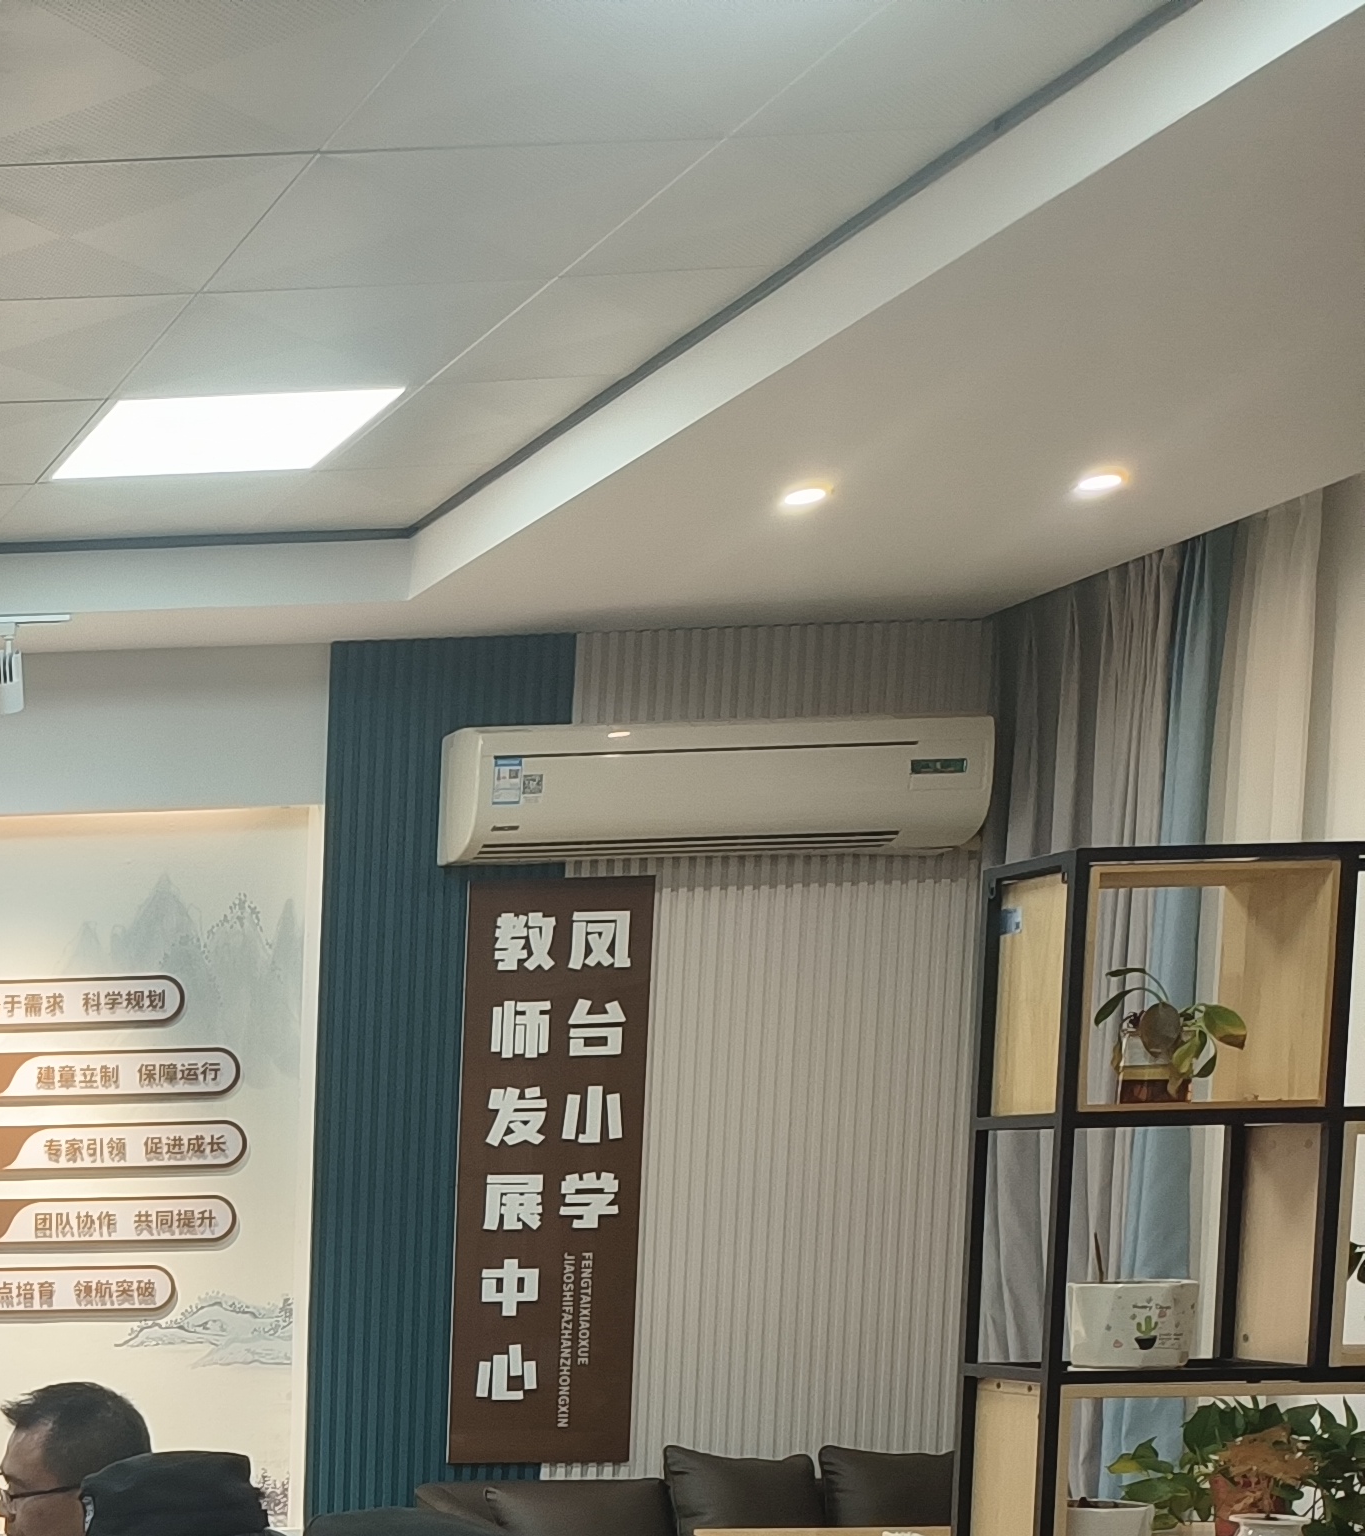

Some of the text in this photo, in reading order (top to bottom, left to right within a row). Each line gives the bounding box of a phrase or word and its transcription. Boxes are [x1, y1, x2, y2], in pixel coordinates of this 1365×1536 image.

[81, 988, 167, 1012] 科学规划
[35, 1061, 222, 1087] 建章立制 保障运行
[559, 909, 632, 1230] 凤台小学
[43, 1134, 228, 1160] 专家引领 促进成长
[475, 910, 557, 1401] 教师发展中心
[34, 1208, 217, 1233] 团队协作 共同提升
[73, 1278, 156, 1300] 领航突破
[577, 1252, 594, 1366] FENGTAIXIAOXUE
[557, 1251, 576, 1428] JIAOSHIFAZHANZHONGXIN
